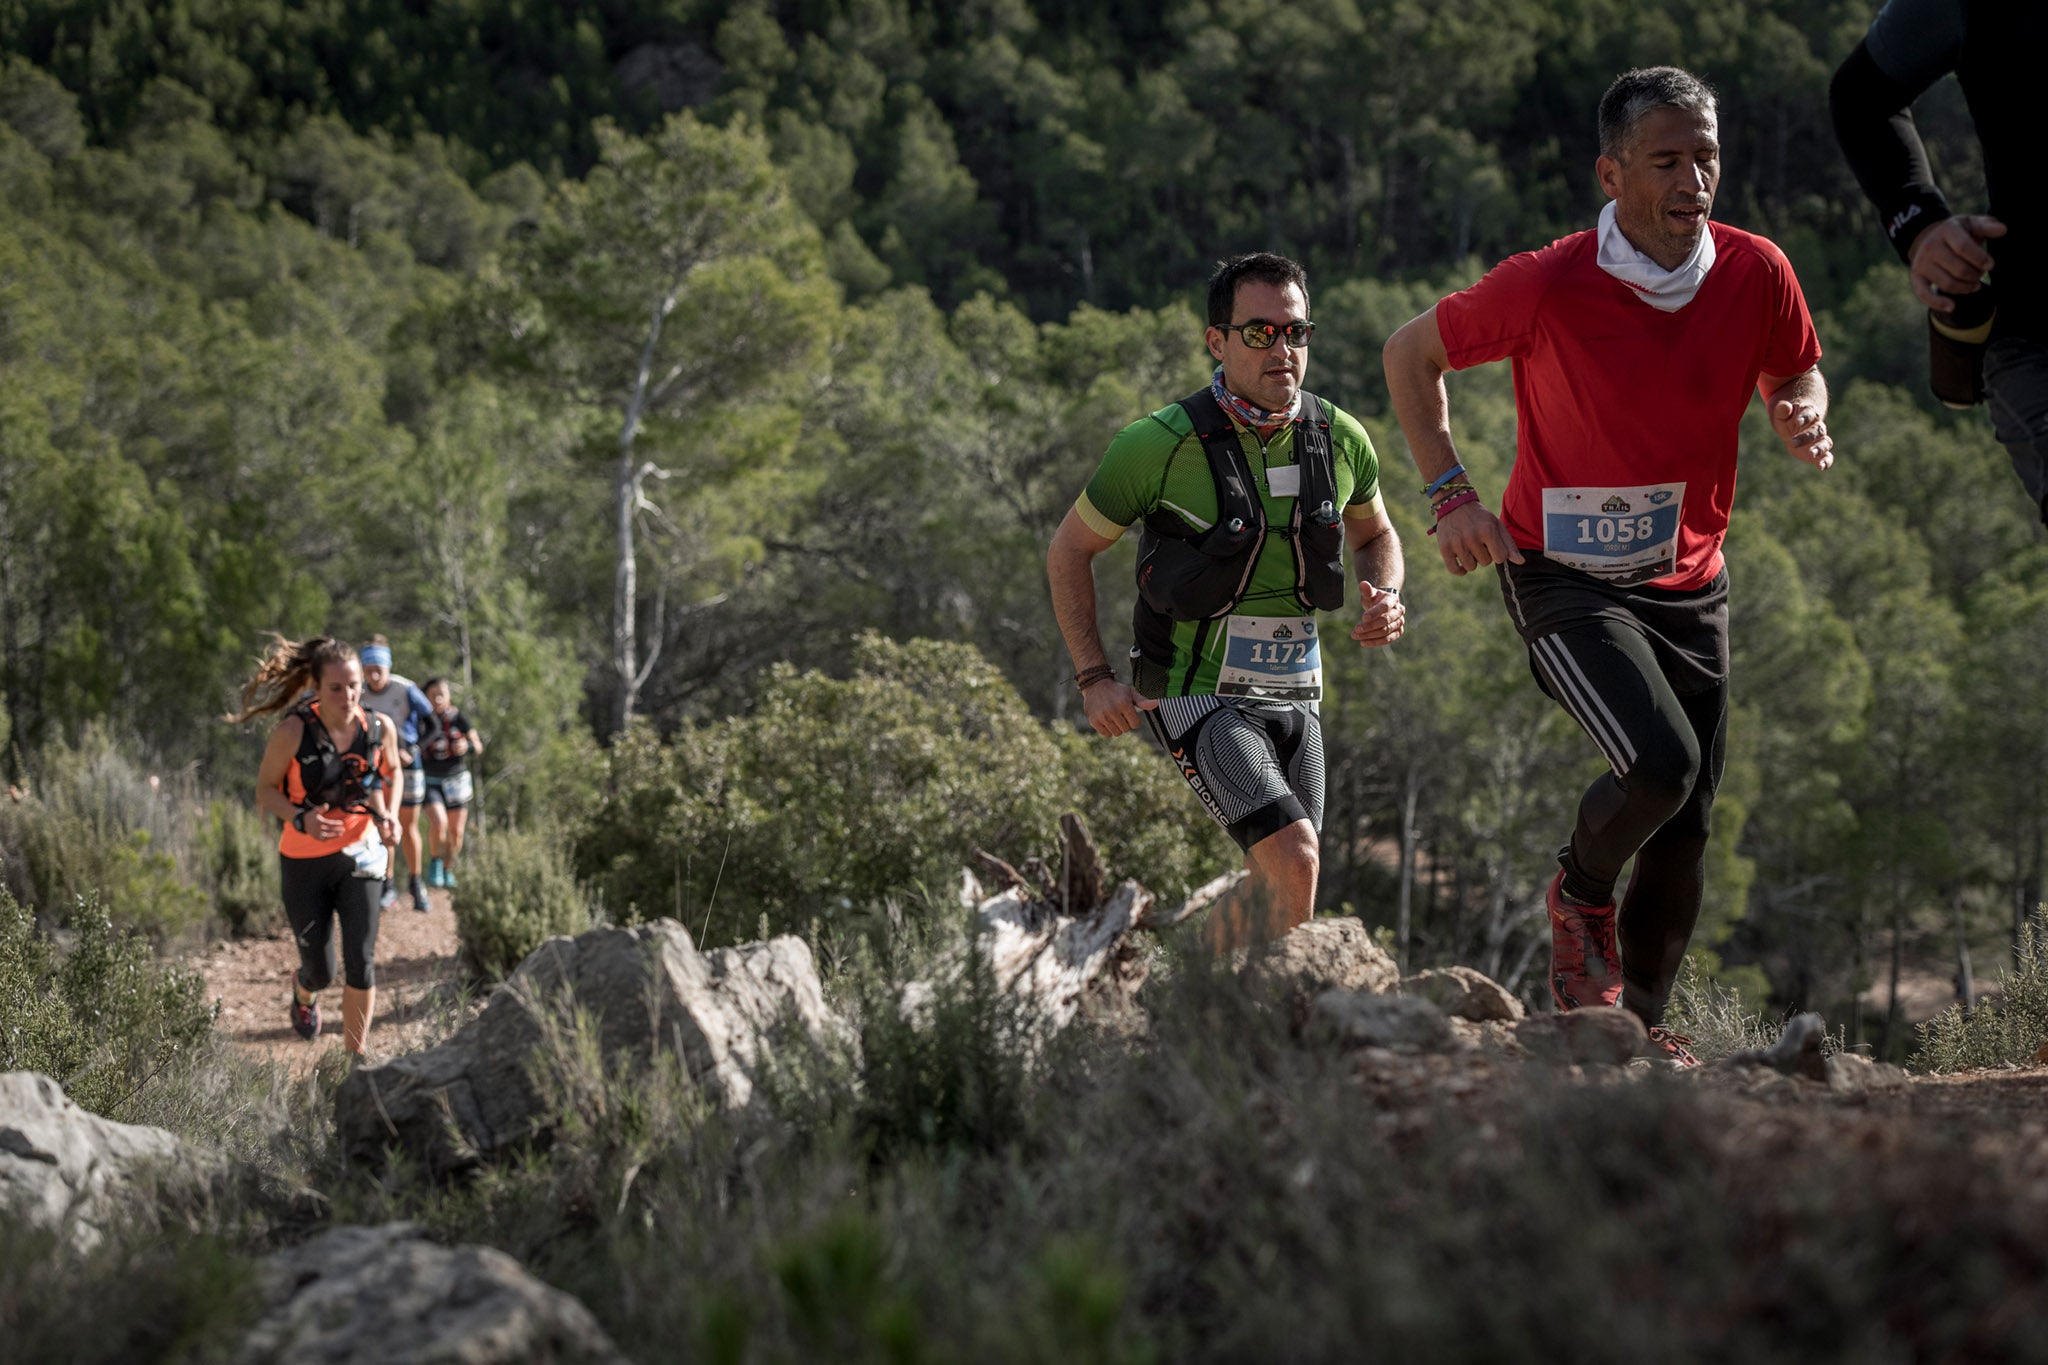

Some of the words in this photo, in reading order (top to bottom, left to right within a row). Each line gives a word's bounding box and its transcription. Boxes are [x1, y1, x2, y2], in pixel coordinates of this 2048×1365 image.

[1603, 504, 1629, 512] TRAIL
[1577, 516, 1653, 544] 1058
[1250, 643, 1306, 664] 1172
